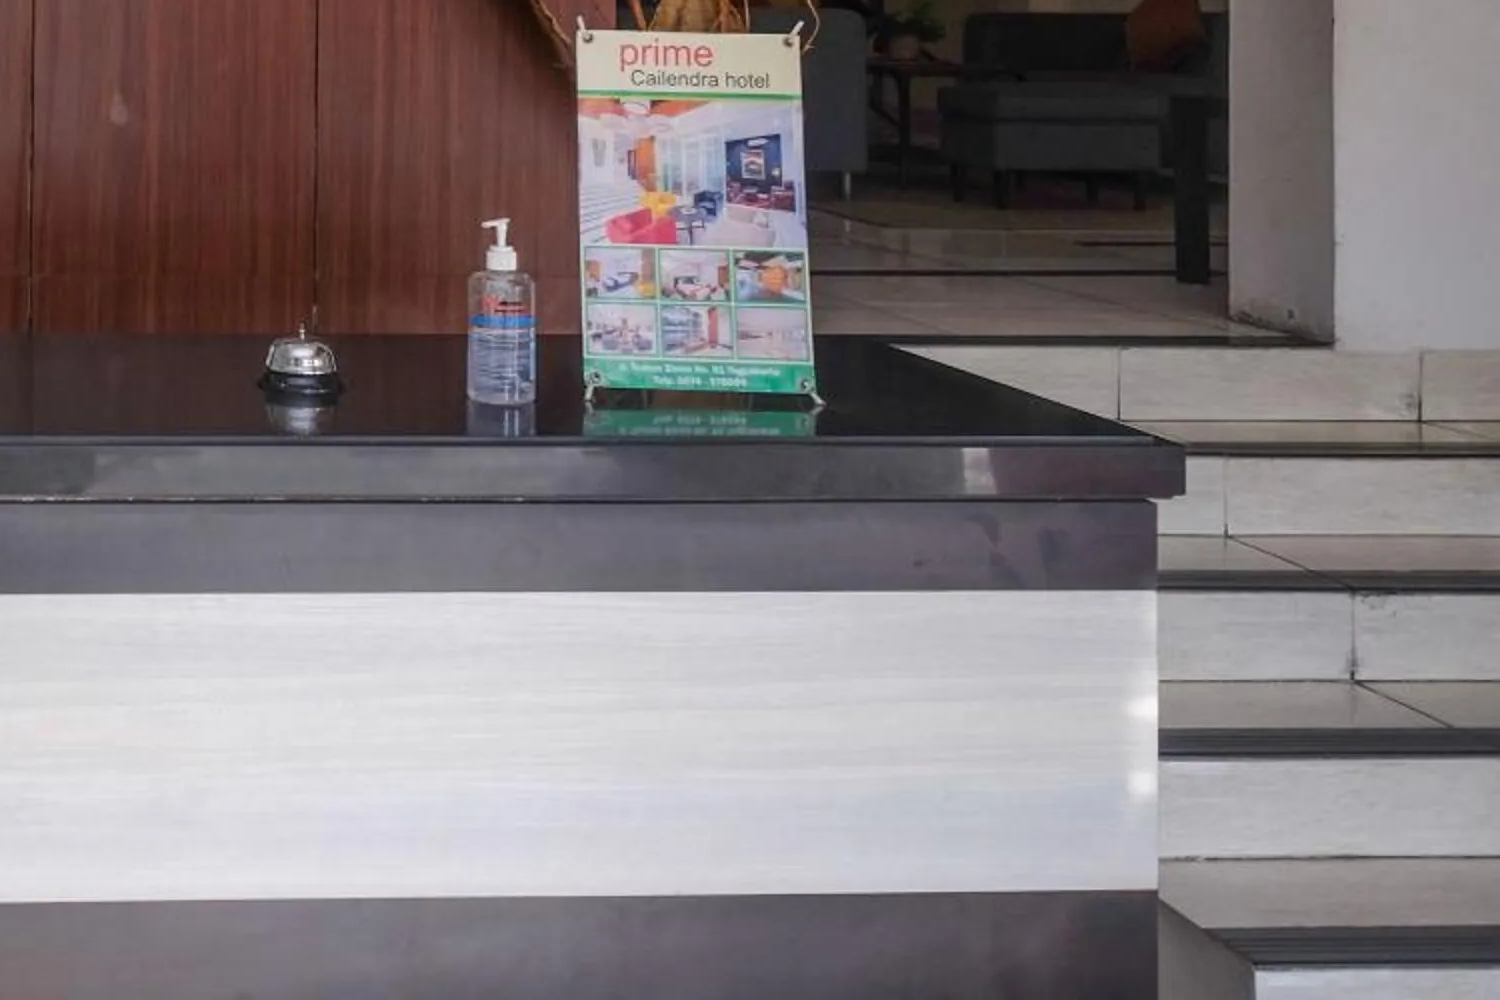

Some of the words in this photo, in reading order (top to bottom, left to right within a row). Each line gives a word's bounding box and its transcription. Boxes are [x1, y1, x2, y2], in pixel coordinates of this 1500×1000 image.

[619, 38, 714, 72] prime
[630, 69, 719, 88] Cailendra
[725, 71, 770, 89] hotel
